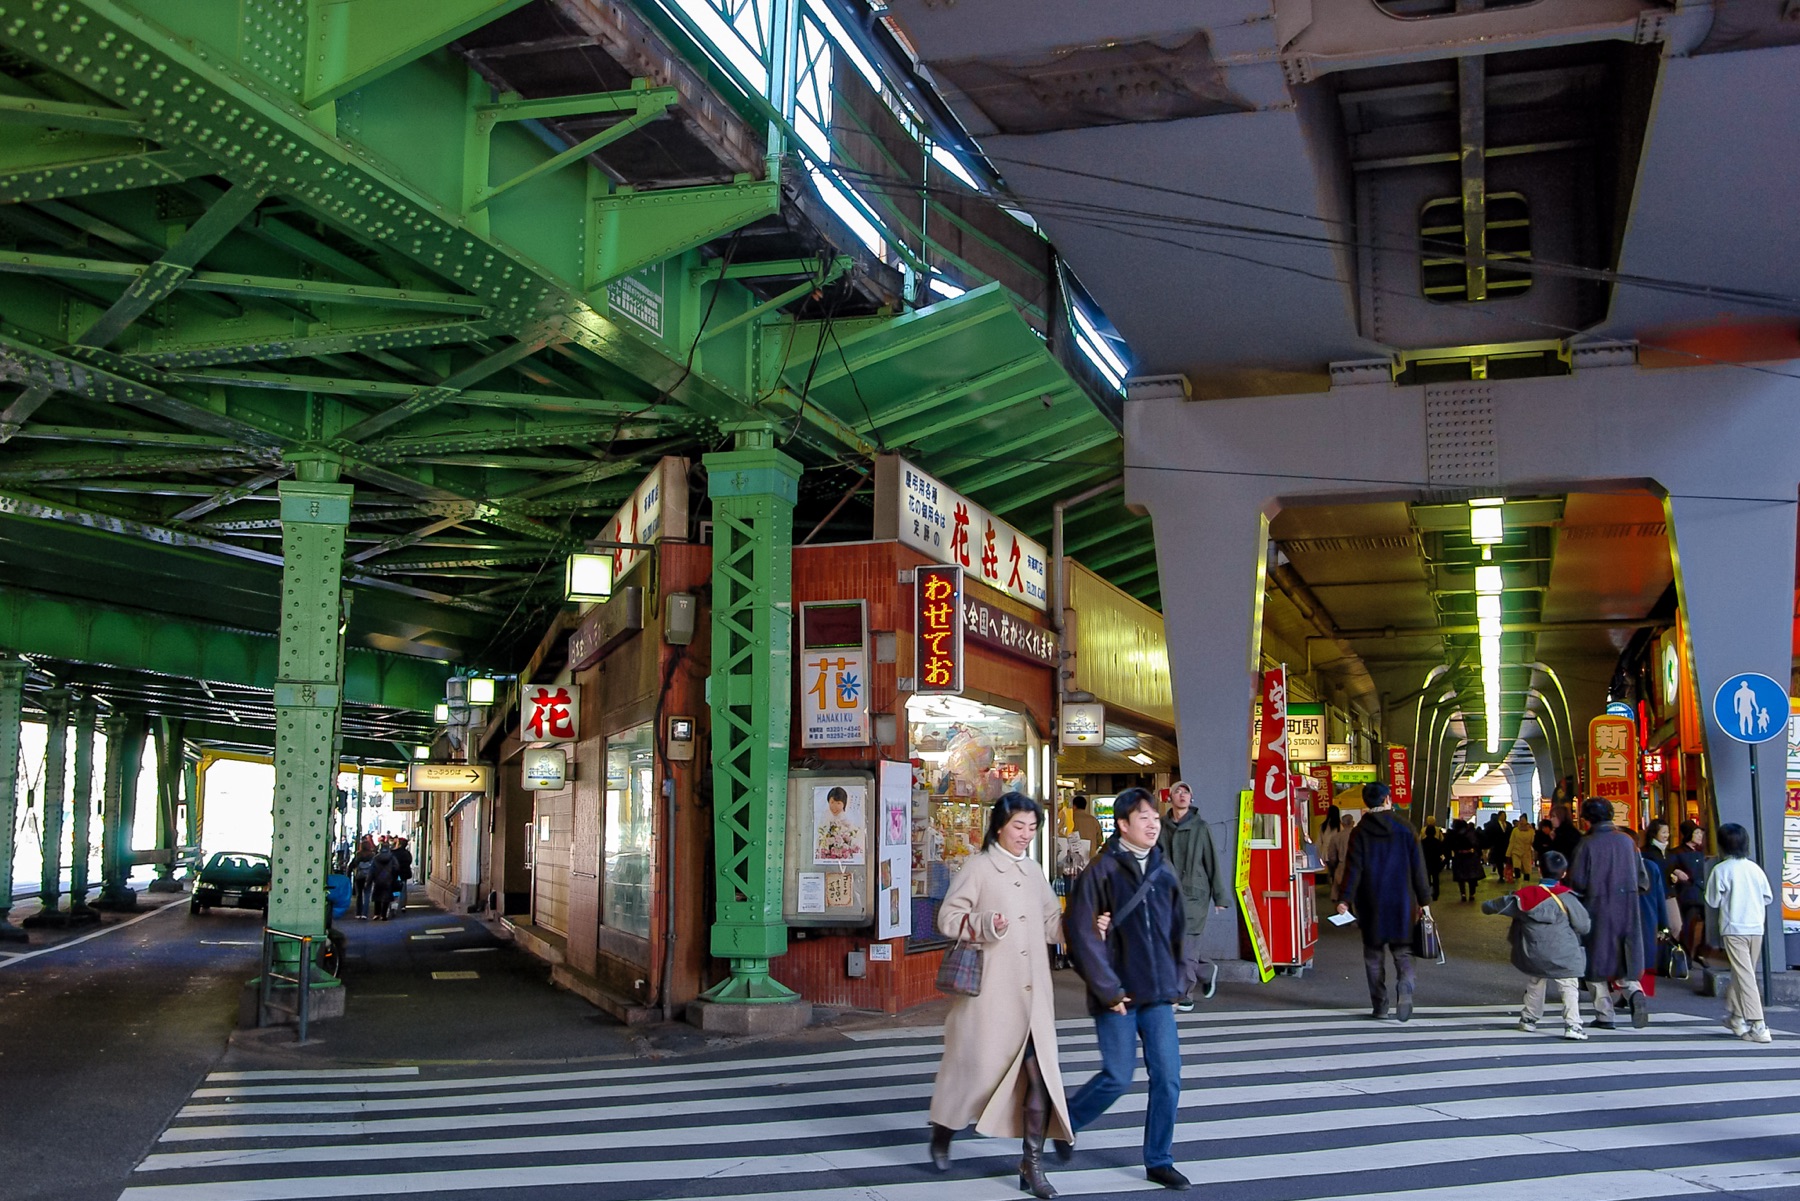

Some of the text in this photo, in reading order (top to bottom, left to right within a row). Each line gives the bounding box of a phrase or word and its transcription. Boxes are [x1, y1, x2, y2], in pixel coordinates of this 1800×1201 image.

[909, 494, 946, 529] 花の御用命は
[923, 574, 953, 685] わせてお
[808, 657, 861, 710] 花
[525, 687, 574, 739] 花
[816, 712, 853, 724] HANAKIKU
[1253, 718, 1320, 735] 有町駅
[1265, 679, 1288, 801] 宝くじ
[1294, 738, 1321, 747] STATION
[1595, 724, 1629, 779] 新台
